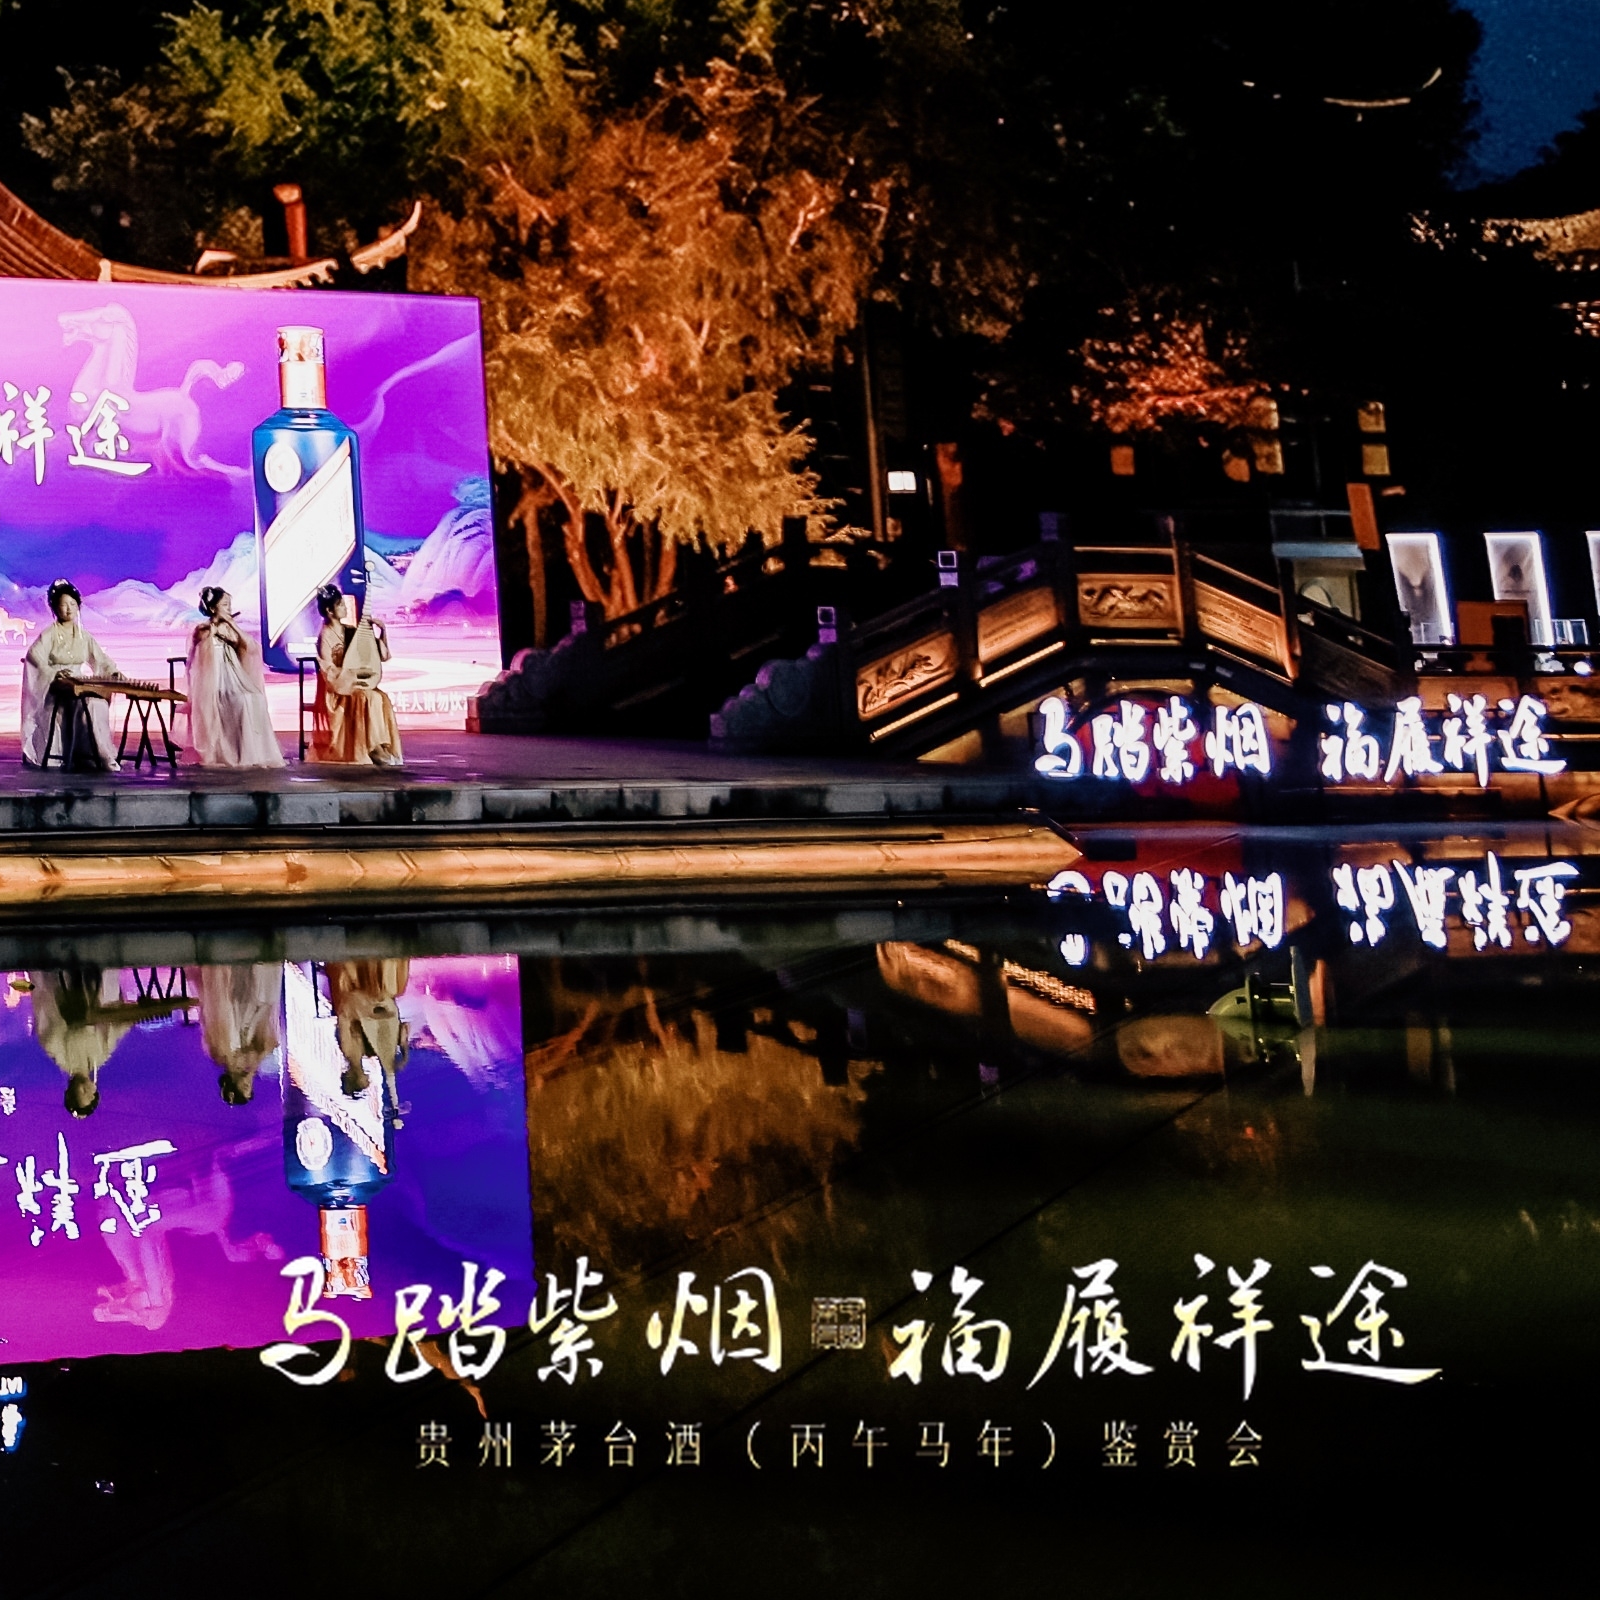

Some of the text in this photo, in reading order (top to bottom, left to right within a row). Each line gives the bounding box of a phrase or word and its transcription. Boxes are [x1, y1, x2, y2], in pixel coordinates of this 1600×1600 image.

[1034, 692, 1568, 788] 马踏紫烟 福履祥途
